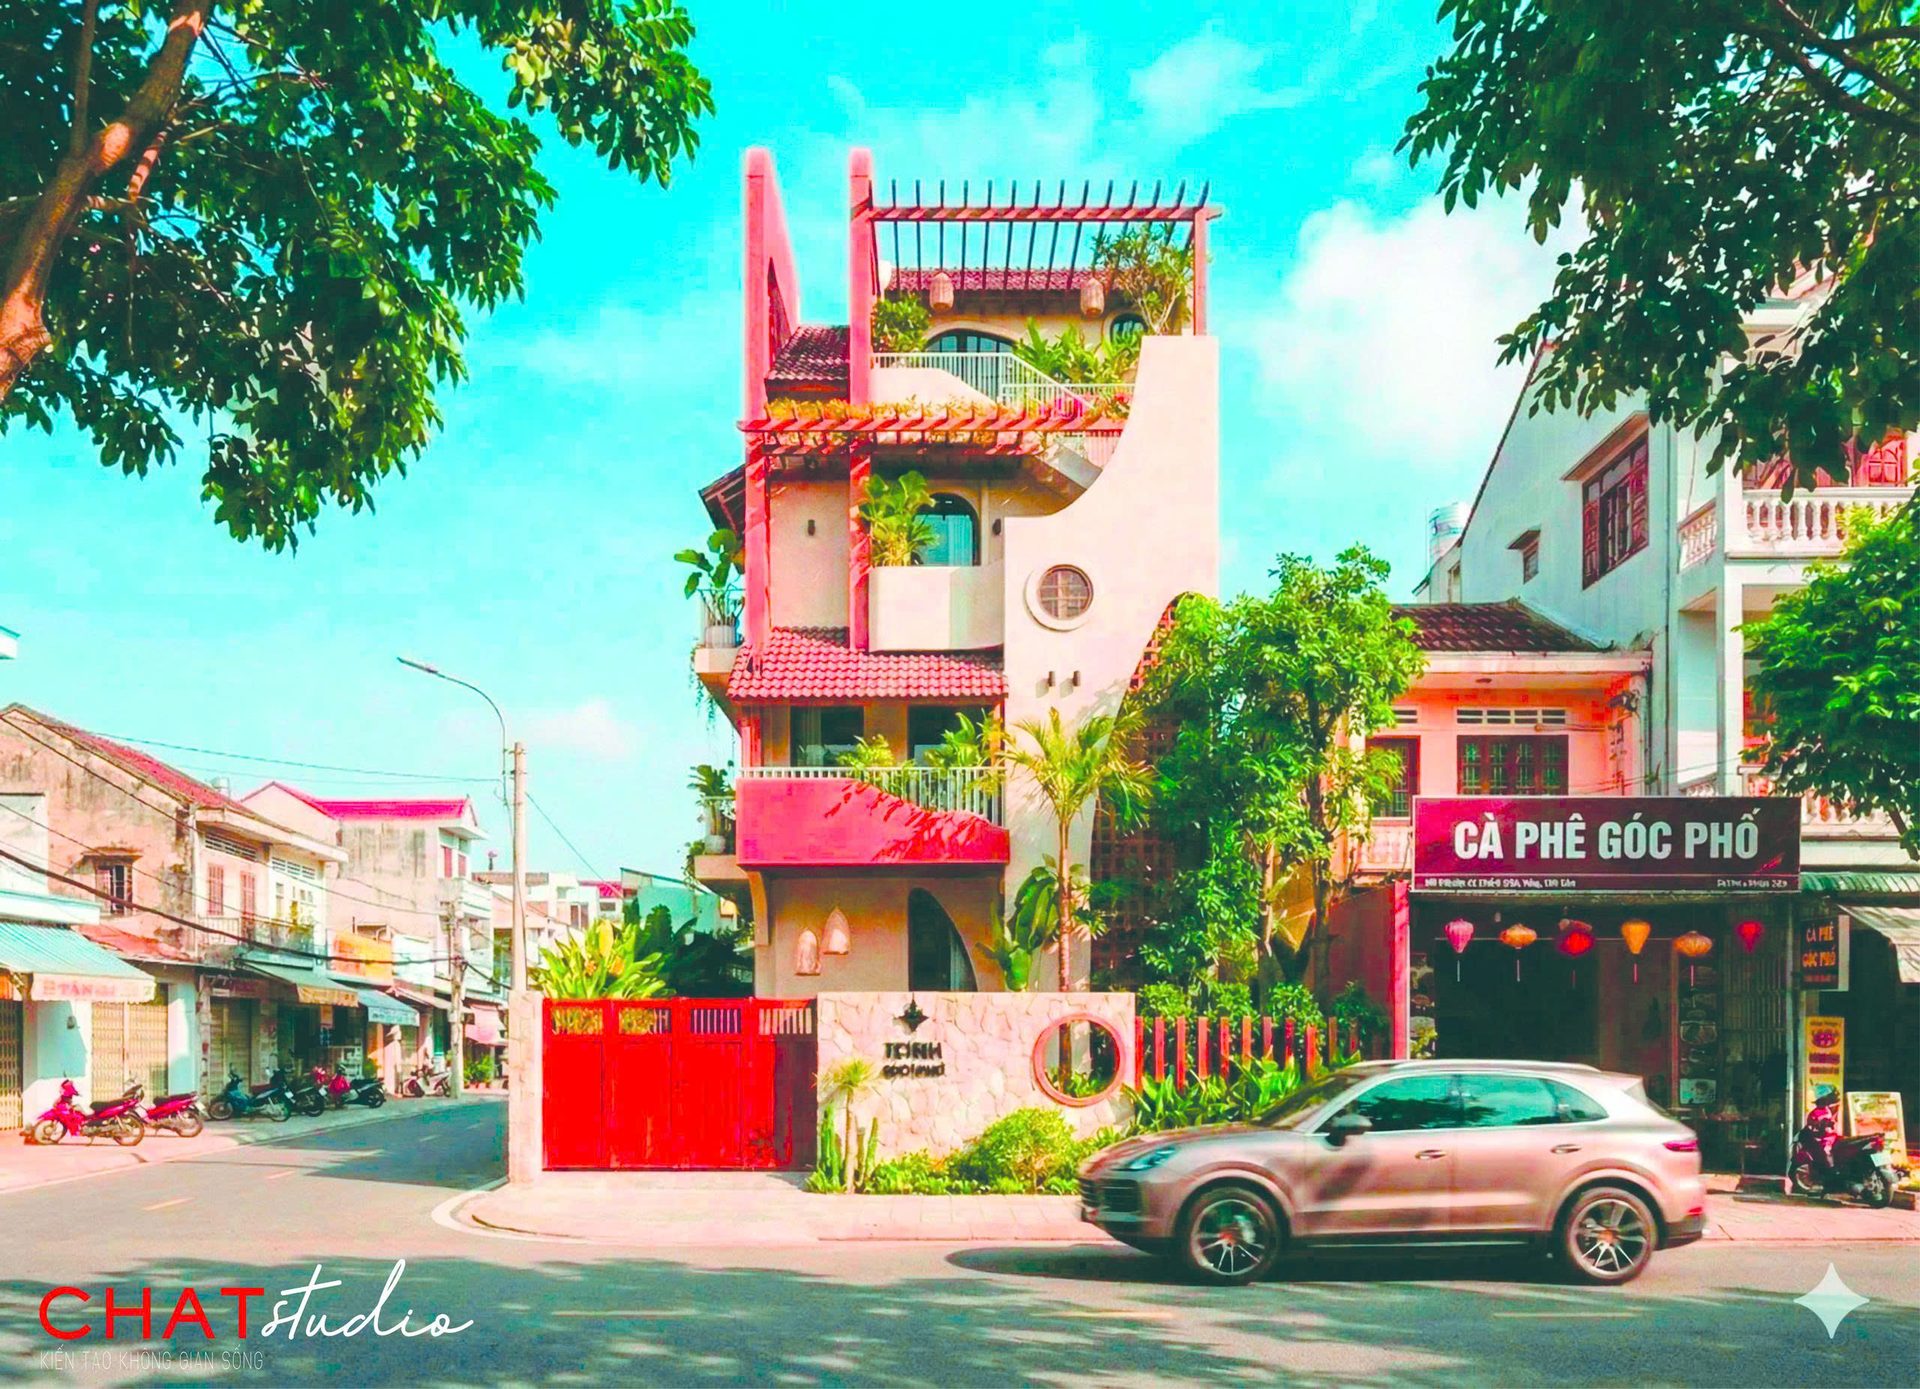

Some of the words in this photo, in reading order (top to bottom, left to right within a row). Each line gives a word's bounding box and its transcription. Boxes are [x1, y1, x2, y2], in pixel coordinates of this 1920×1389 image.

[1454, 812, 1504, 860] CÀ
[1515, 812, 1587, 859] PHÊ
[1598, 812, 1672, 860] GÓC
[1684, 807, 1761, 860] PHỐ
